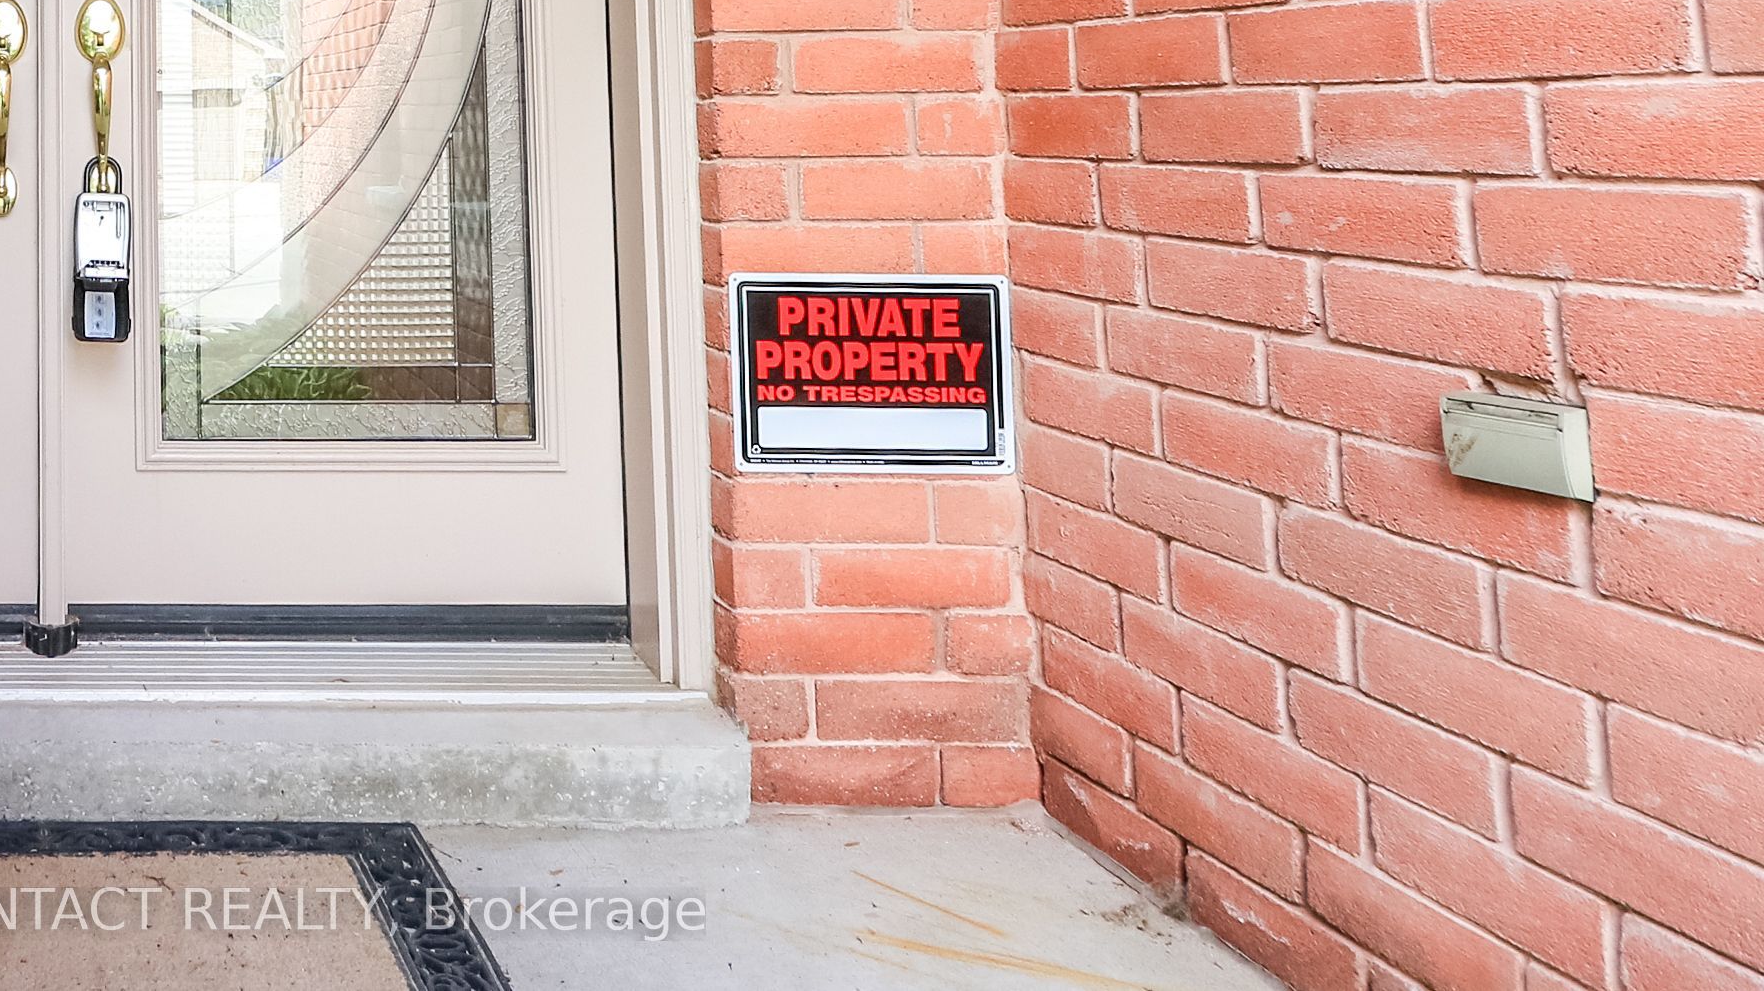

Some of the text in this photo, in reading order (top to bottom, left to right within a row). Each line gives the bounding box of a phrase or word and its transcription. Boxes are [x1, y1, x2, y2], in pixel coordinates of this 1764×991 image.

[777, 296, 961, 338] PRIVATE
[755, 340, 984, 382] PROPERTY
[757, 385, 987, 403] NO TRESPASSING
